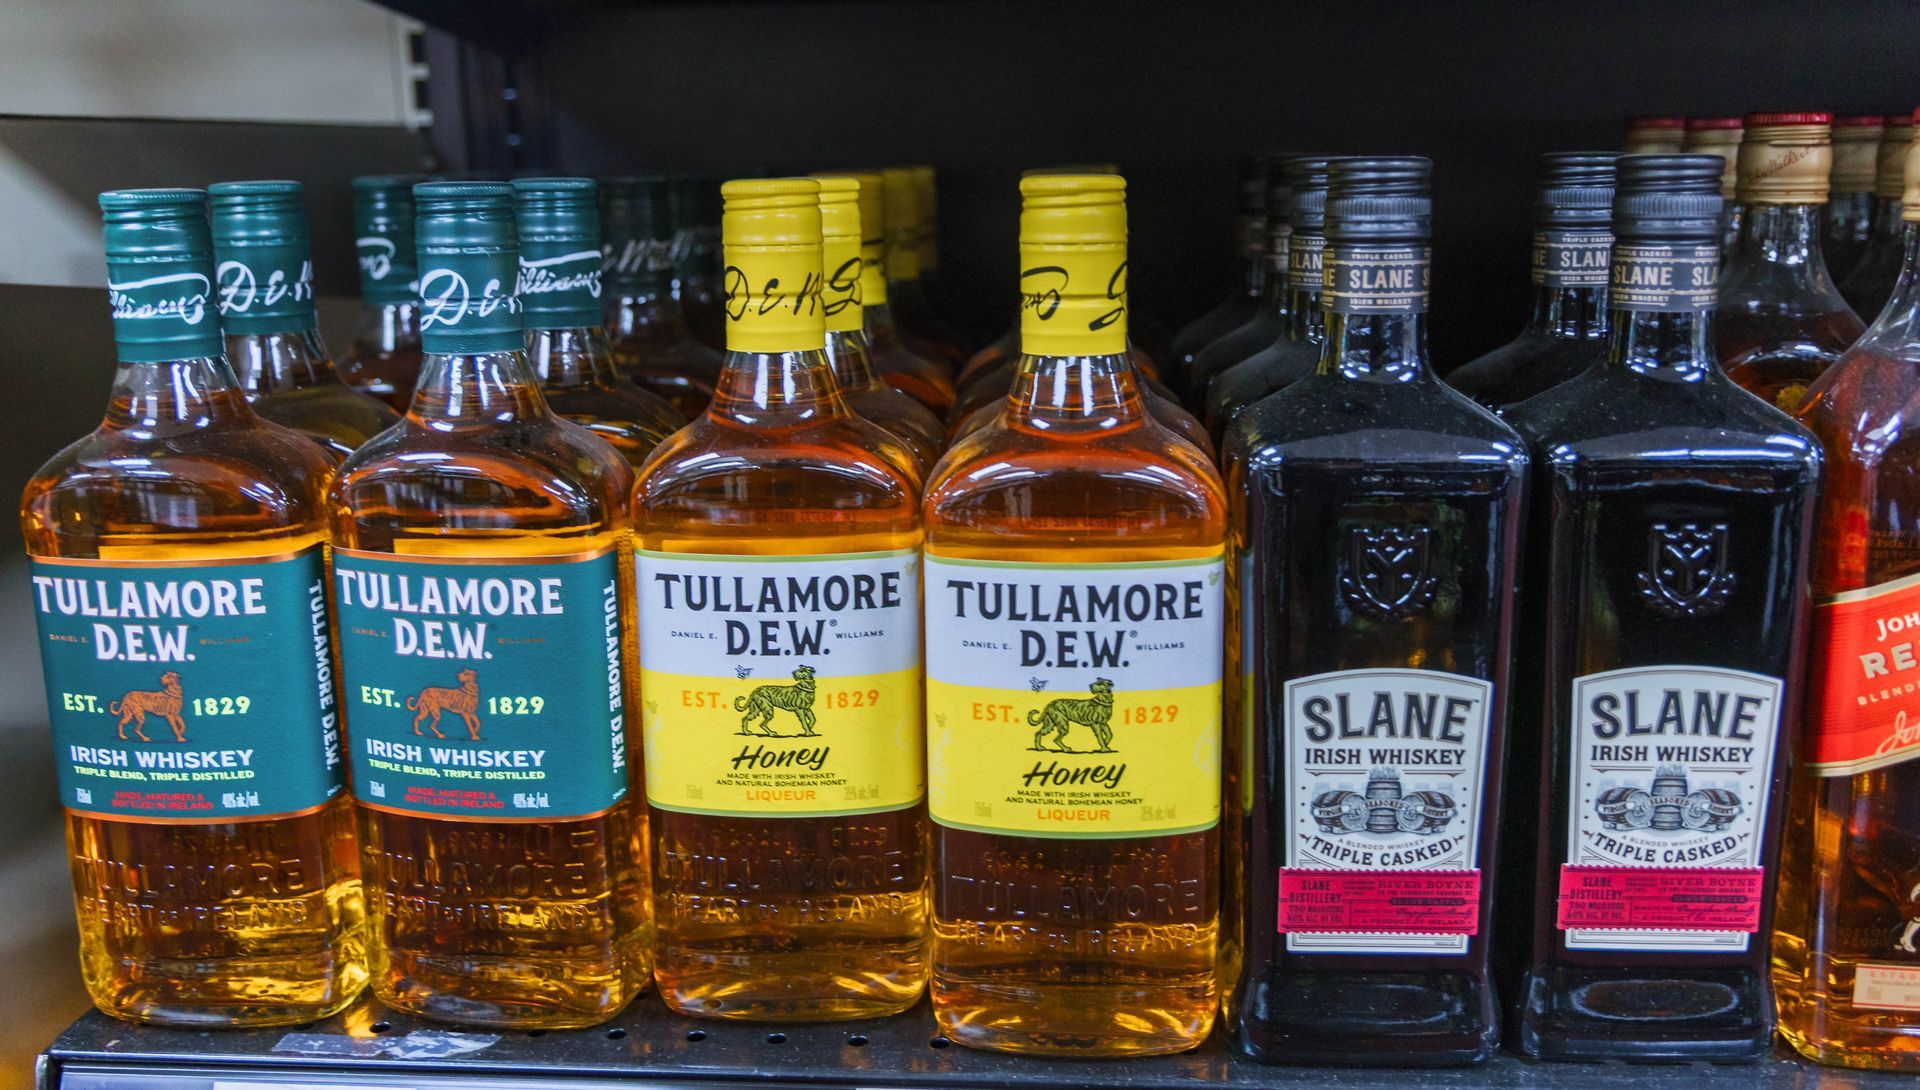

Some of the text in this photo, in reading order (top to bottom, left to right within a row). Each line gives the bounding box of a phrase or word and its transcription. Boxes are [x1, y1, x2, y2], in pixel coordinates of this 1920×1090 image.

[1290, 253, 1323, 269] SLAN
[1560, 251, 1609, 267] SLAN
[1349, 269, 1414, 289] SLANE
[1614, 266, 1673, 286] SLANE
[1692, 266, 1719, 286] SLA
[33, 576, 266, 618] TULLAMORE
[336, 567, 564, 616] TULLAMORE
[655, 571, 901, 613] TULLAMORE
[946, 579, 1203, 623] TULLAMORE
[671, 630, 718, 640] DANIEL E.
[835, 629, 884, 640] WILLIAMS
[1876, 612, 1920, 642] JOH
[93, 623, 195, 661] D.E.W.
[393, 617, 493, 660] D.E.W.
[603, 580, 622, 712] TULLAMORE
[962, 640, 1012, 650] DANIEL E.
[1135, 641, 1185, 651] WILLIAMS
[1858, 641, 1920, 680] RE
[309, 579, 334, 710] TULLAMORE
[322, 711, 340, 771] D.E.W.
[63, 692, 250, 716] EST. 1829
[361, 685, 545, 715] EST. 1829
[682, 689, 879, 710] EST. 1829
[972, 702, 1179, 724] EST. 1829
[1302, 691, 1474, 745] SLANE
[1590, 688, 1763, 742] SLANE
[366, 738, 546, 767] IRISH WHISKEY
[611, 714, 625, 774] D.E.W.
[1591, 745, 1754, 763] IRISH WHISKEY
[71, 744, 254, 768] IRISH WHISKEY
[731, 744, 830, 771] Honey
[1305, 747, 1466, 765] IRISH WHISKEY
[74, 765, 255, 781] TRIPLE BLEND, TRIPLE DISTILLED
[368, 758, 546, 780] TRIPLE BLEND, TRIPLE DISTILLED
[727, 771, 836, 780] MADE WITH IRISH WHISKEY
[1022, 761, 1126, 789] Honey
[735, 779, 773, 787] NATURAL
[774, 779, 818, 787] BOHEMIAN
[820, 778, 848, 786] HONEY
[746, 790, 816, 801] LIQUEUR
[1006, 796, 1143, 805] AND NATURAL BOHEMIAN HONEY
[1017, 790, 1131, 798] MADE WITH IRISH WHISKEY
[1037, 809, 1110, 821] LIQUEUR
[1311, 836, 1453, 867] TRIPLE CASKED
[1346, 839, 1384, 851] BLENDED
[1387, 839, 1425, 850] WHISKEY
[1593, 832, 1737, 863] TRIPLE CASKED
[1629, 836, 1668, 847] BLENDED
[1671, 836, 1709, 847] WHISKEY
[1302, 880, 1332, 890] SLANE
[1378, 880, 1422, 889] RIVER
[1427, 880, 1473, 889] BOYNE
[1583, 876, 1612, 888] SLANE
[1660, 877, 1704, 886] RIVER
[1709, 878, 1756, 887] BOYNE
[1570, 889, 1622, 900] DISTILLERY
[1569, 901, 1585, 909] 750
